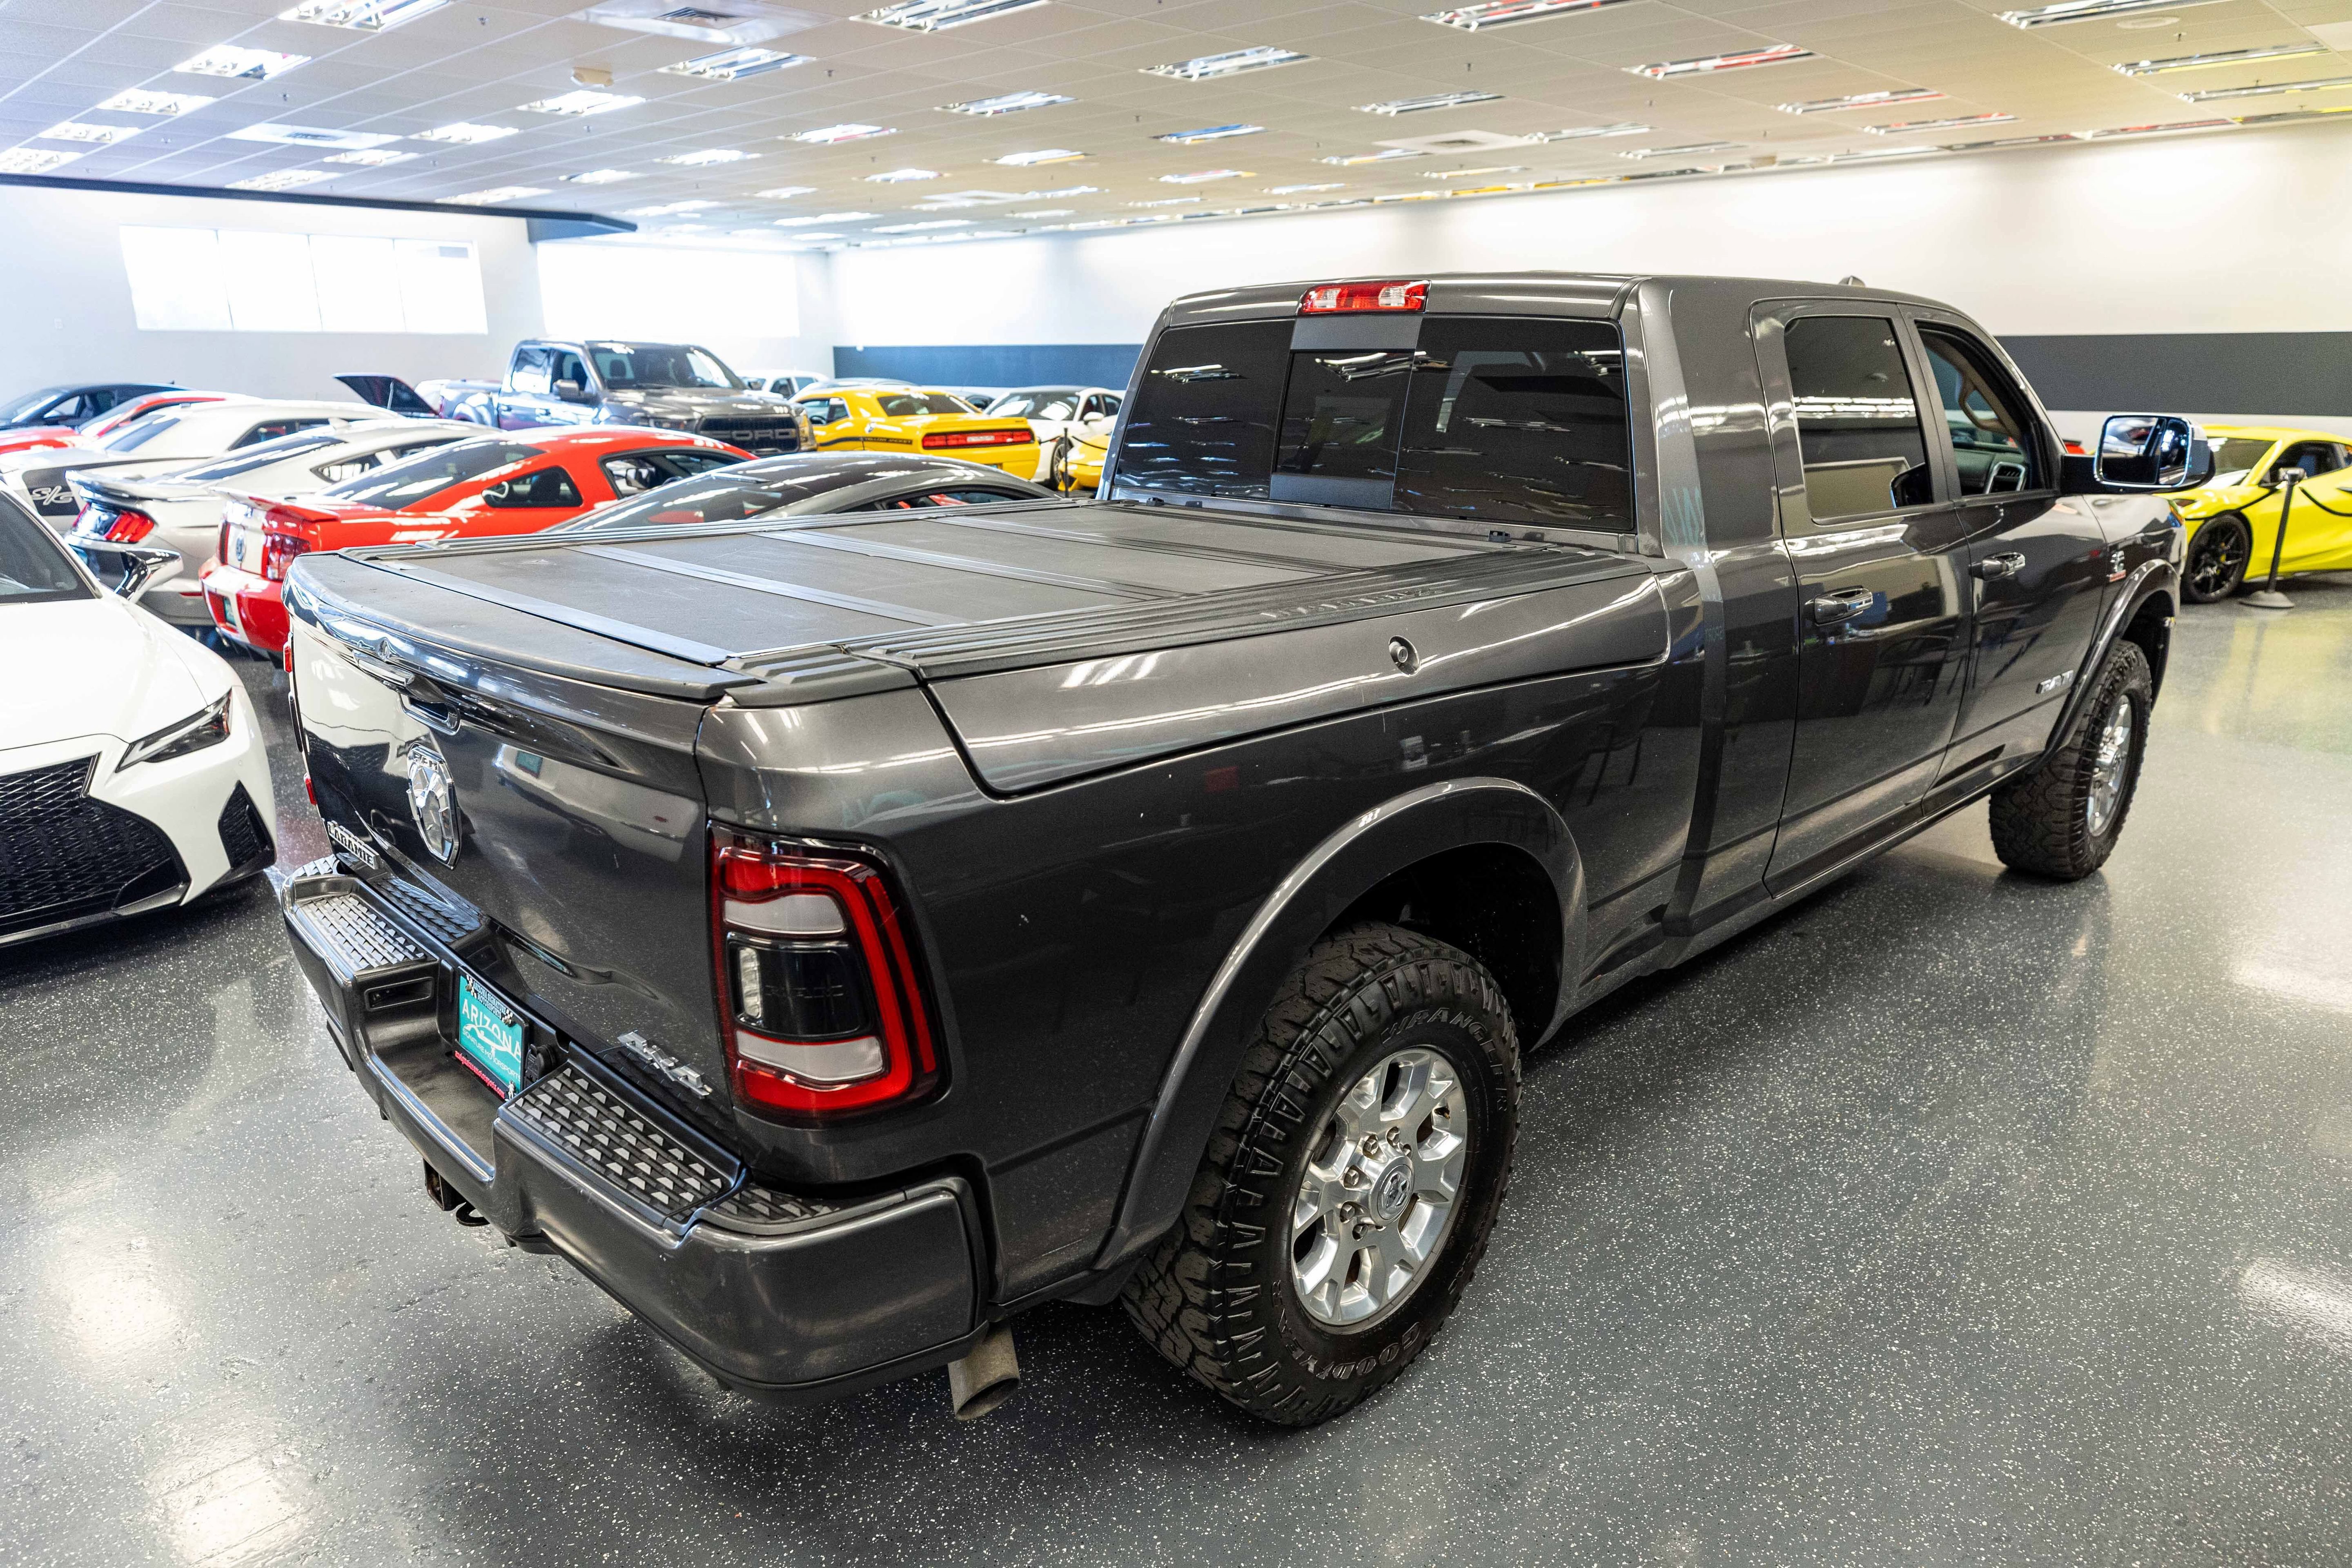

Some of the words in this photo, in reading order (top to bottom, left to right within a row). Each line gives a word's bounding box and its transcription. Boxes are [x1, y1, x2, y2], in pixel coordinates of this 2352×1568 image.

[699, 428, 797, 441] FORD
[327, 820, 380, 870] LARAMIE
[462, 998, 521, 1058] ARIZONA
[477, 992, 502, 1020] MOTORSPORTS
[1272, 1279, 1422, 1380] GOODYEAR
